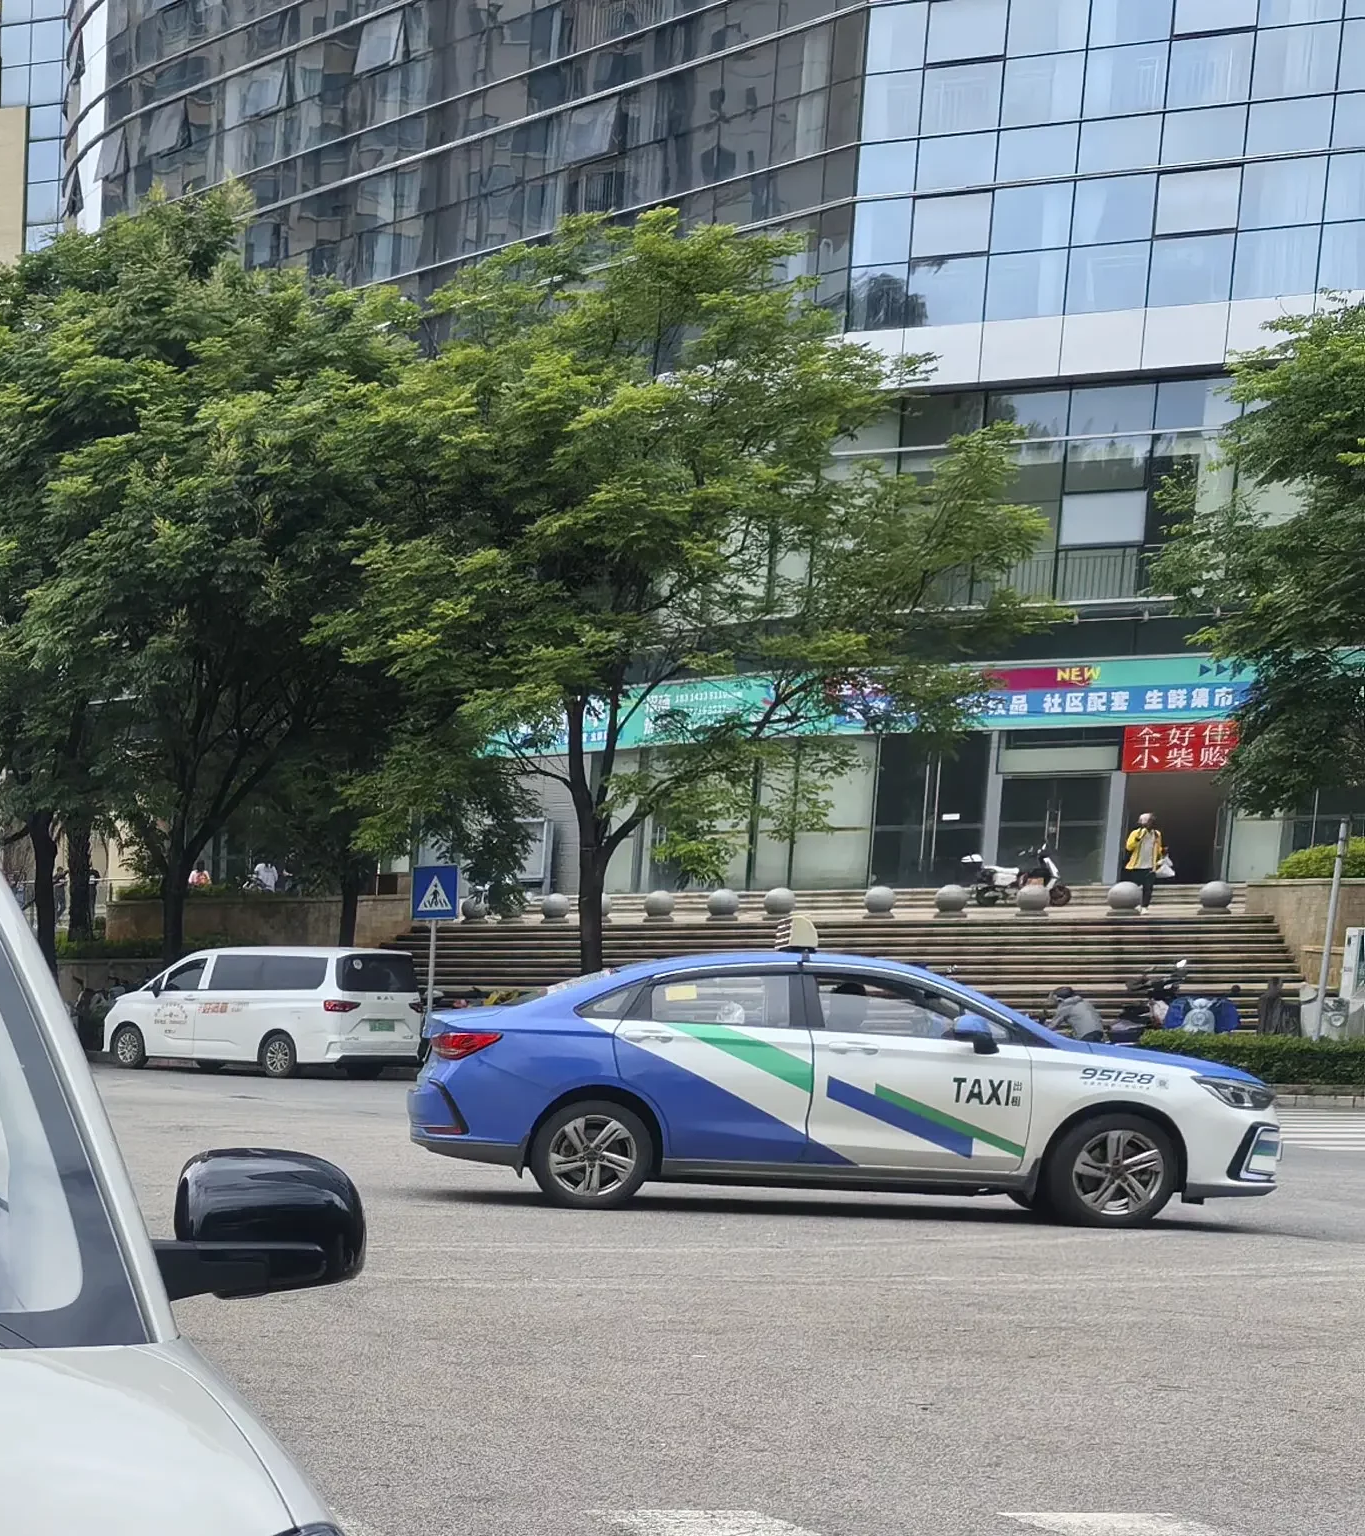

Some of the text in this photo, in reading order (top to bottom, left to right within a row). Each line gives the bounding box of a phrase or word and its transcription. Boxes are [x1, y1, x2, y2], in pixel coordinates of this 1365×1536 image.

[1056, 666, 1102, 682] NEW
[1042, 691, 1130, 713] 社区配套
[1080, 1067, 1155, 1085] 95128
[953, 1077, 1012, 1107] TAXI
